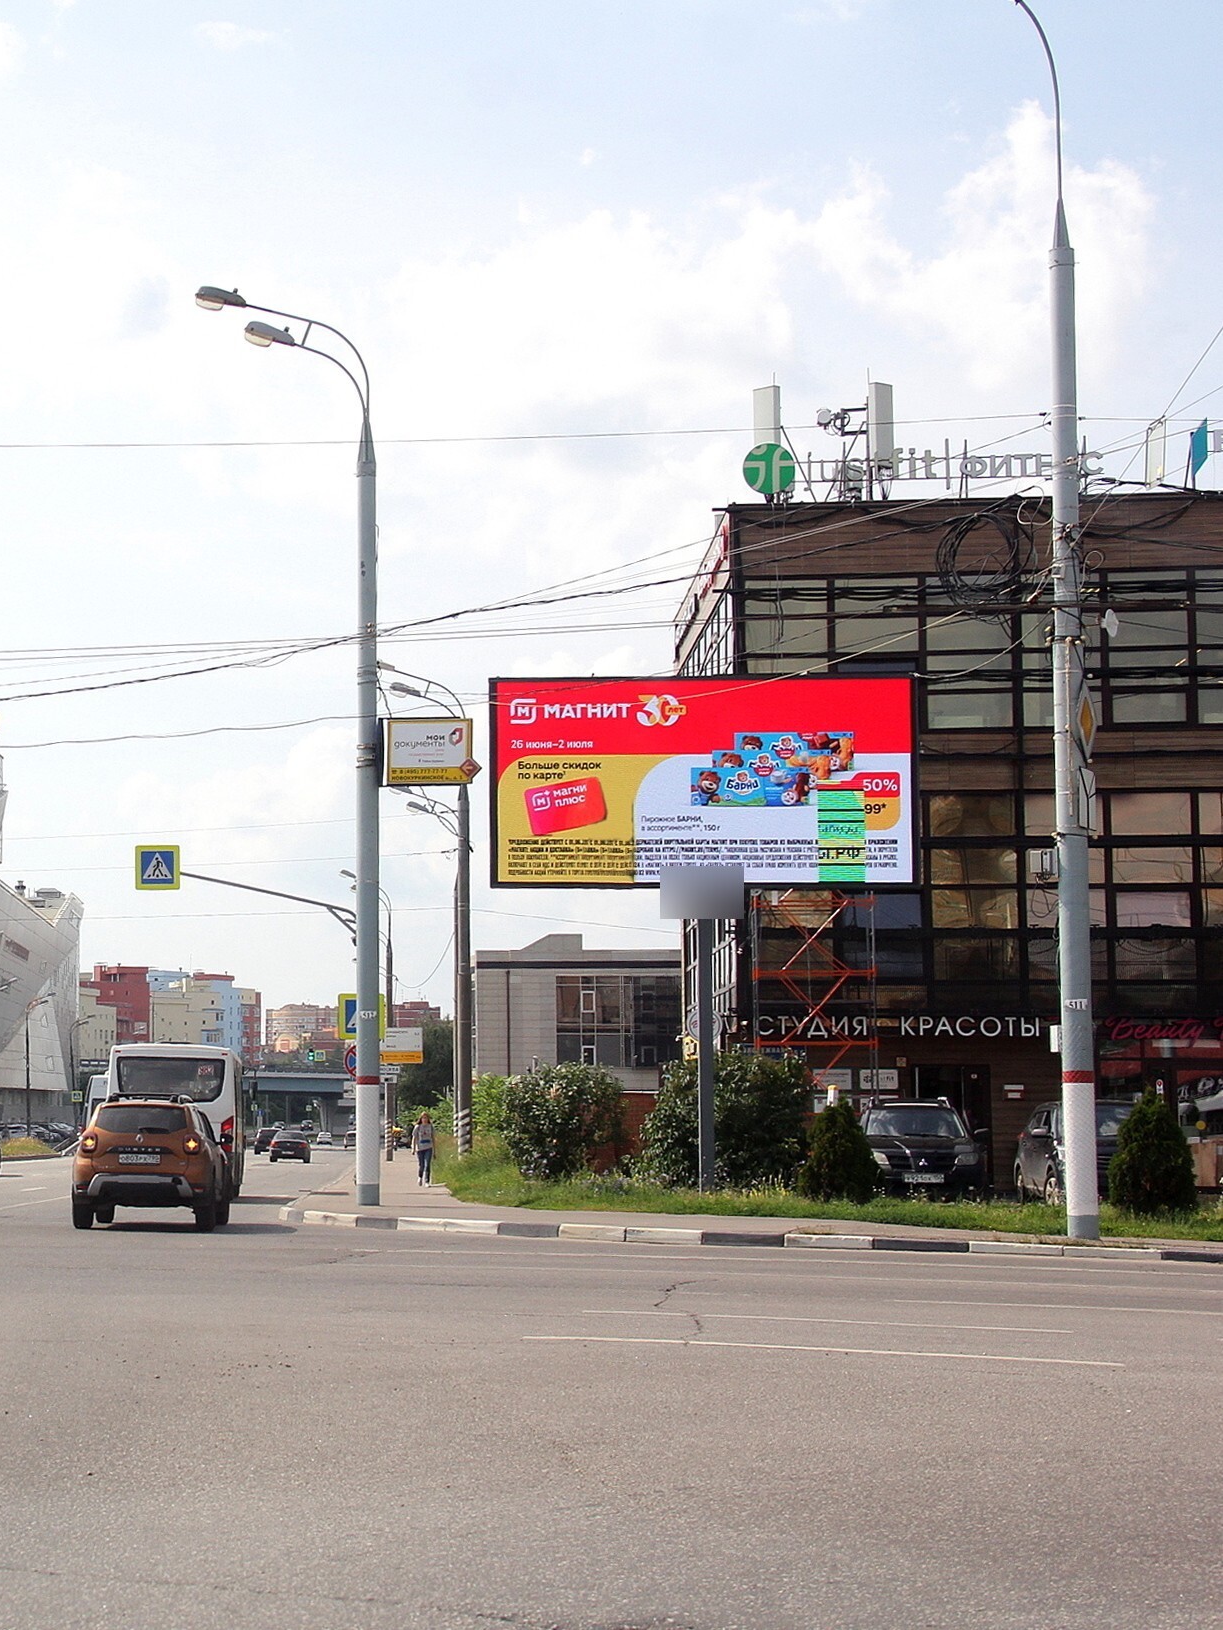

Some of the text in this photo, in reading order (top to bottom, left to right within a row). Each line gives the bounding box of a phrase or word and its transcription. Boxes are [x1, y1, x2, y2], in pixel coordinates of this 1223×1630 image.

[959, 451, 1104, 479] ФИТНС
[543, 703, 631, 719] МАГНИТ
[636, 694, 680, 726] 30
[667, 706, 684, 714] лет
[510, 740, 524, 749] 26
[566, 740, 594, 749] июля
[518, 761, 602, 771] Больше скидок
[518, 772, 531, 780] по
[725, 779, 760, 791] Барни
[862, 779, 898, 792] 50%
[554, 794, 586, 808] плюс
[641, 815, 704, 824] Пирожное БАРНИ,
[703, 824, 716, 832] 150
[757, 1014, 1041, 1039] СТУДИЯ КРАСОТЫ
[1106, 1017, 1205, 1043] Beauty
